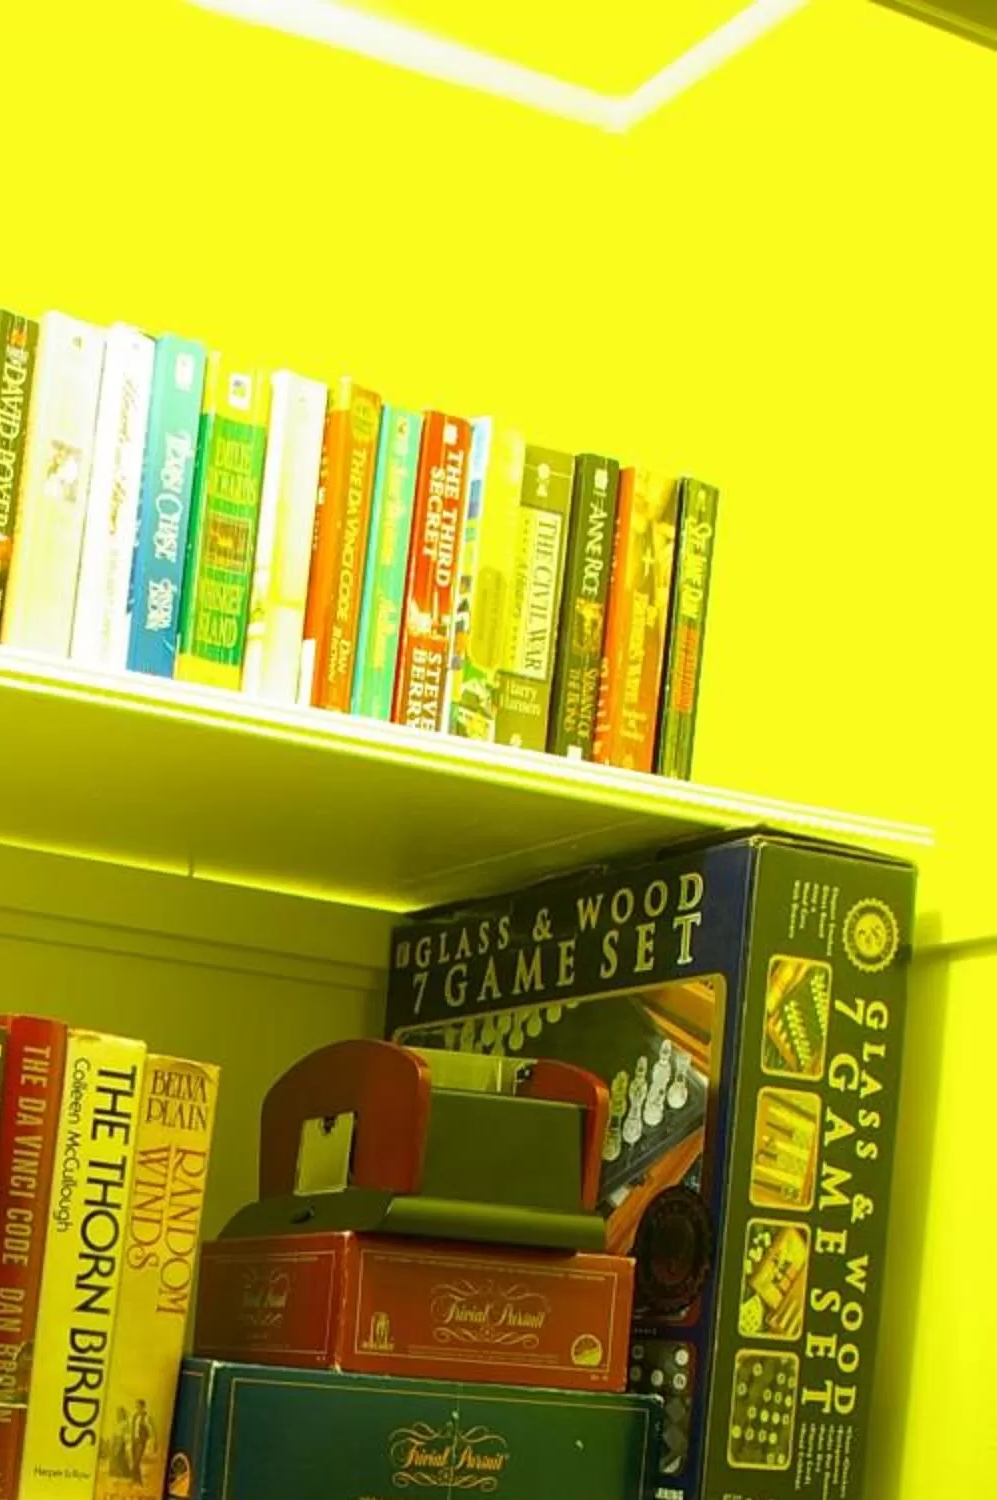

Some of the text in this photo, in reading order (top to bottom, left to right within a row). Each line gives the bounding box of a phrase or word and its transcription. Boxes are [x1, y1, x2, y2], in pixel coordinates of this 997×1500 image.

[346, 488, 364, 515] DA
[350, 449, 367, 487] THE
[153, 493, 184, 561] CHASE
[422, 467, 444, 561] SECRET
[434, 449, 463, 587] THE THIRD
[581, 502, 607, 597] ANNE RICE
[336, 570, 356, 622] CODE
[524, 519, 557, 672] THE CIVIL WAR
[405, 647, 426, 731] BERRY
[420, 652, 442, 732] STEVE
[411, 972, 428, 1015] 7
[443, 938, 578, 1009] GAME
[598, 911, 703, 981] SET
[415, 914, 512, 970] GLASS
[531, 907, 555, 943] &
[575, 871, 705, 935] WOOD
[834, 997, 865, 1028] 7
[19, 1044, 51, 1085] THE
[150, 1069, 207, 1104] BELVA
[18, 1097, 46, 1127] DA
[52, 1056, 92, 1234] Colleen McCullough
[145, 1098, 207, 1131] PLAIN
[814, 1053, 859, 1255] GAME
[7, 1135, 43, 1198] VINCI
[127, 1145, 171, 1271] WINDS
[832, 1000, 890, 1416] GLASS & WOOD
[2, 1208, 36, 1267] CODE
[58, 1065, 138, 1449] THE THORN BIRDS
[155, 1145, 208, 1316] RANDOM
[800, 1287, 841, 1415] SET
